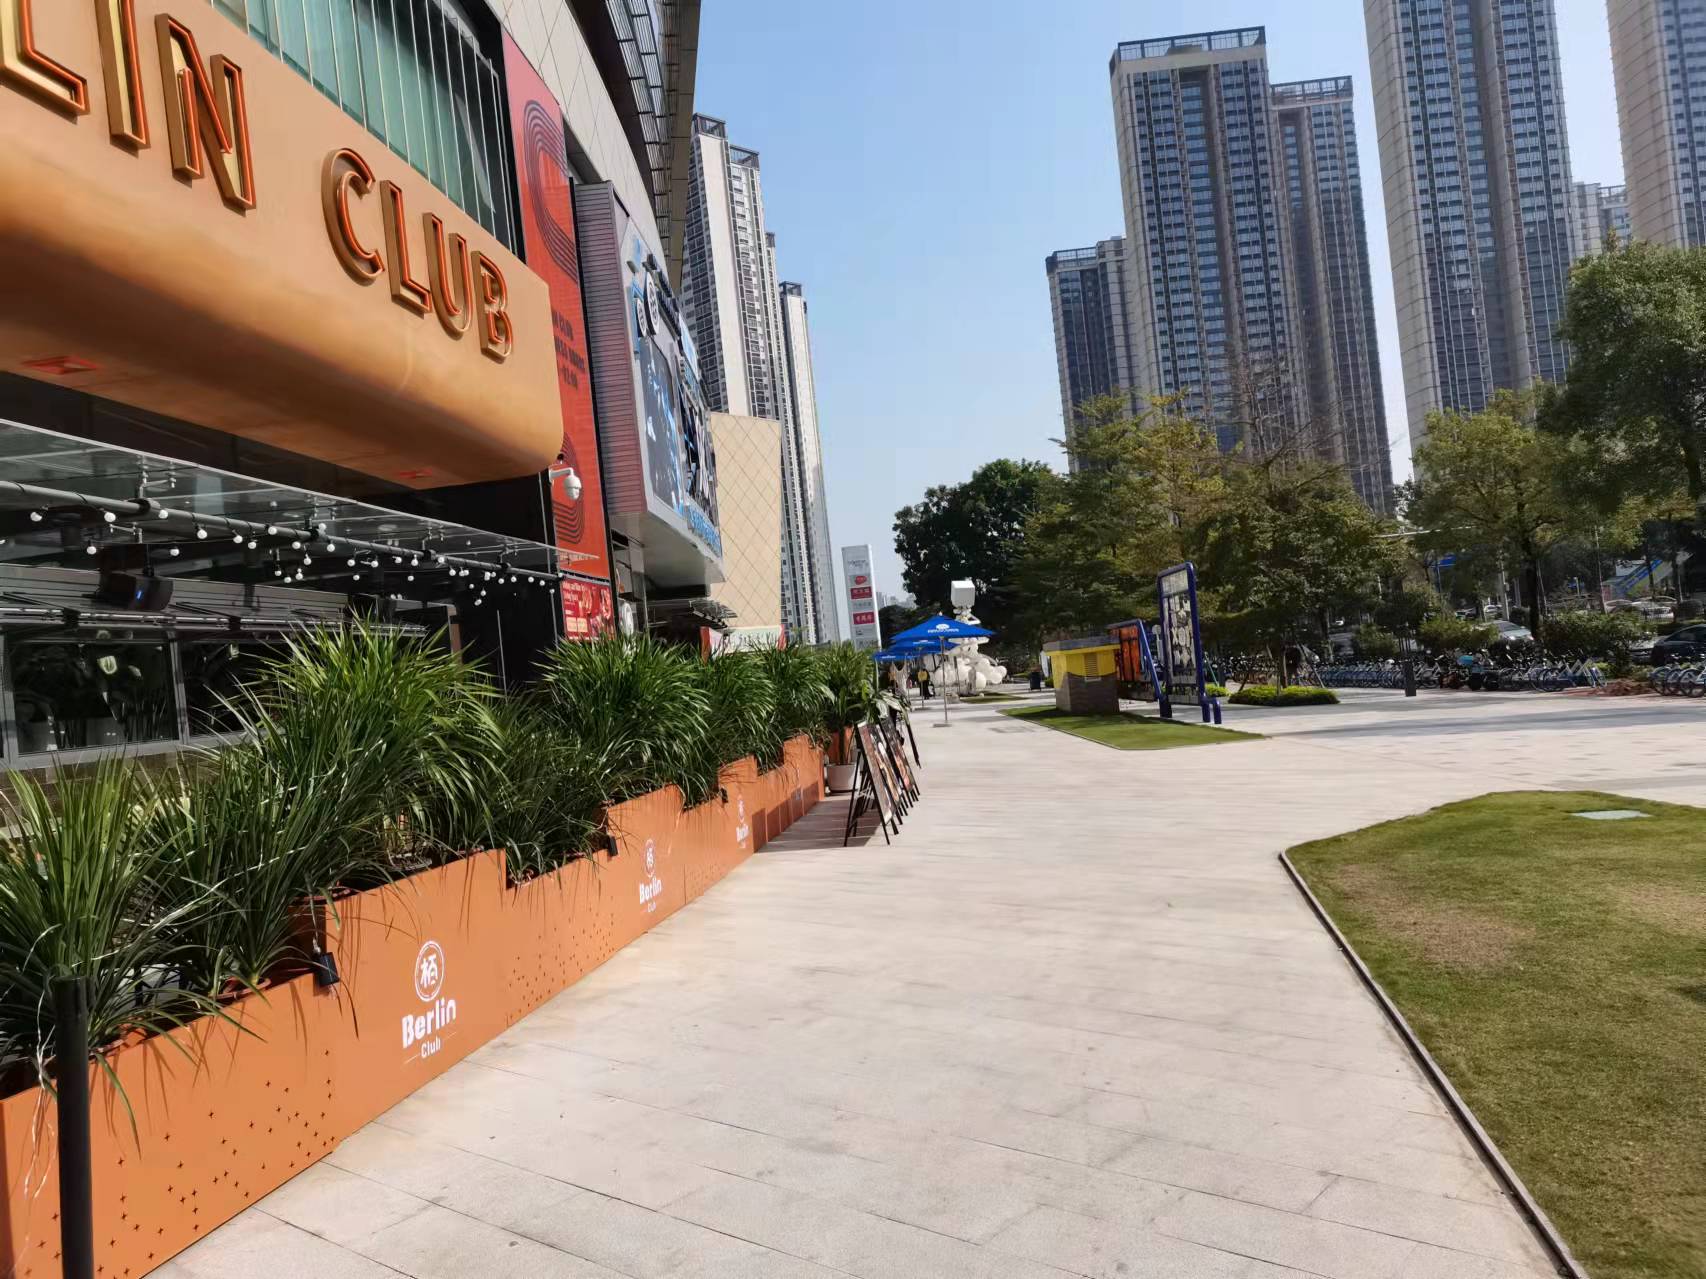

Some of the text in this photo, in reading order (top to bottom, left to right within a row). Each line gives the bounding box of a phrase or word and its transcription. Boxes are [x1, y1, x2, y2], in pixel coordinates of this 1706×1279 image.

[321, 148, 514, 358] CLUB
[639, 876, 662, 905] Berlin
[401, 997, 457, 1049] Berlin
[421, 1035, 441, 1058] Club
